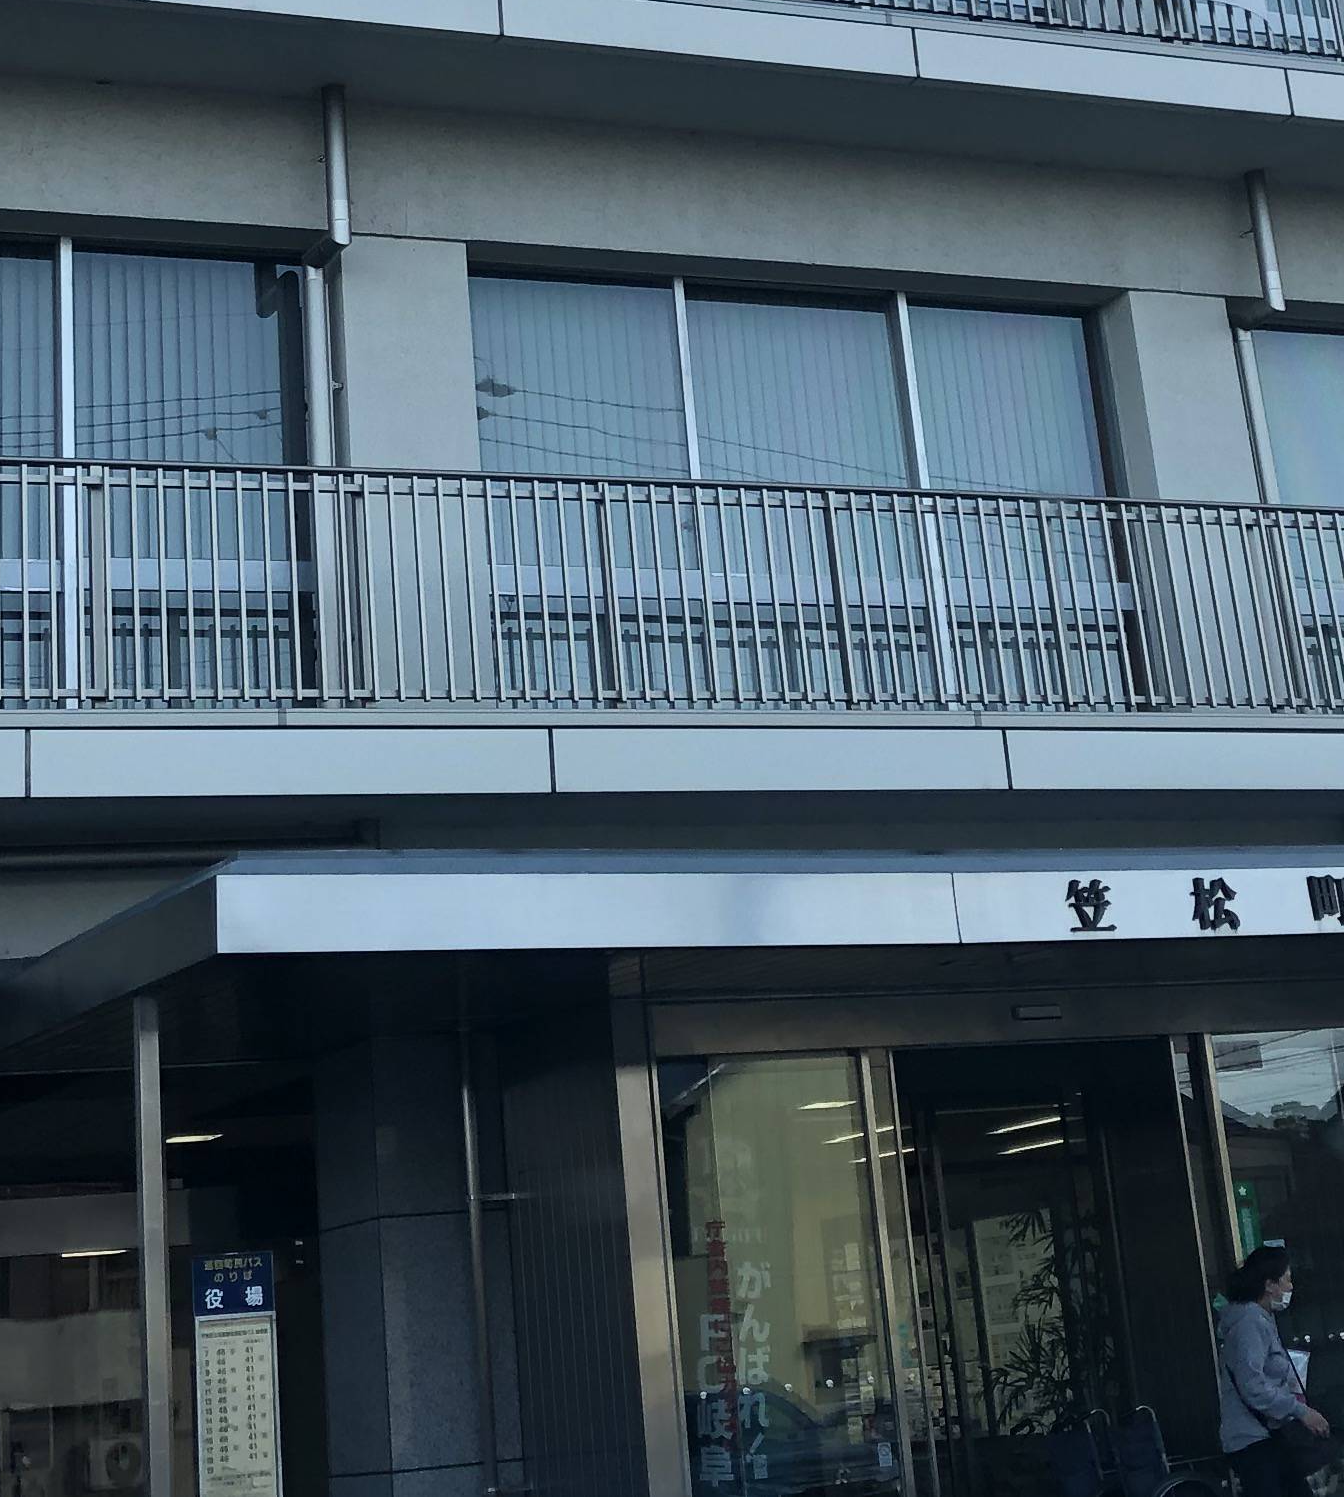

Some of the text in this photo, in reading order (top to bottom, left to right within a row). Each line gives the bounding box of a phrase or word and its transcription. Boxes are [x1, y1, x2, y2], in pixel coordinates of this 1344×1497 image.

[214, 1270, 253, 1282] のりば
[204, 1285, 264, 1309] 役場
